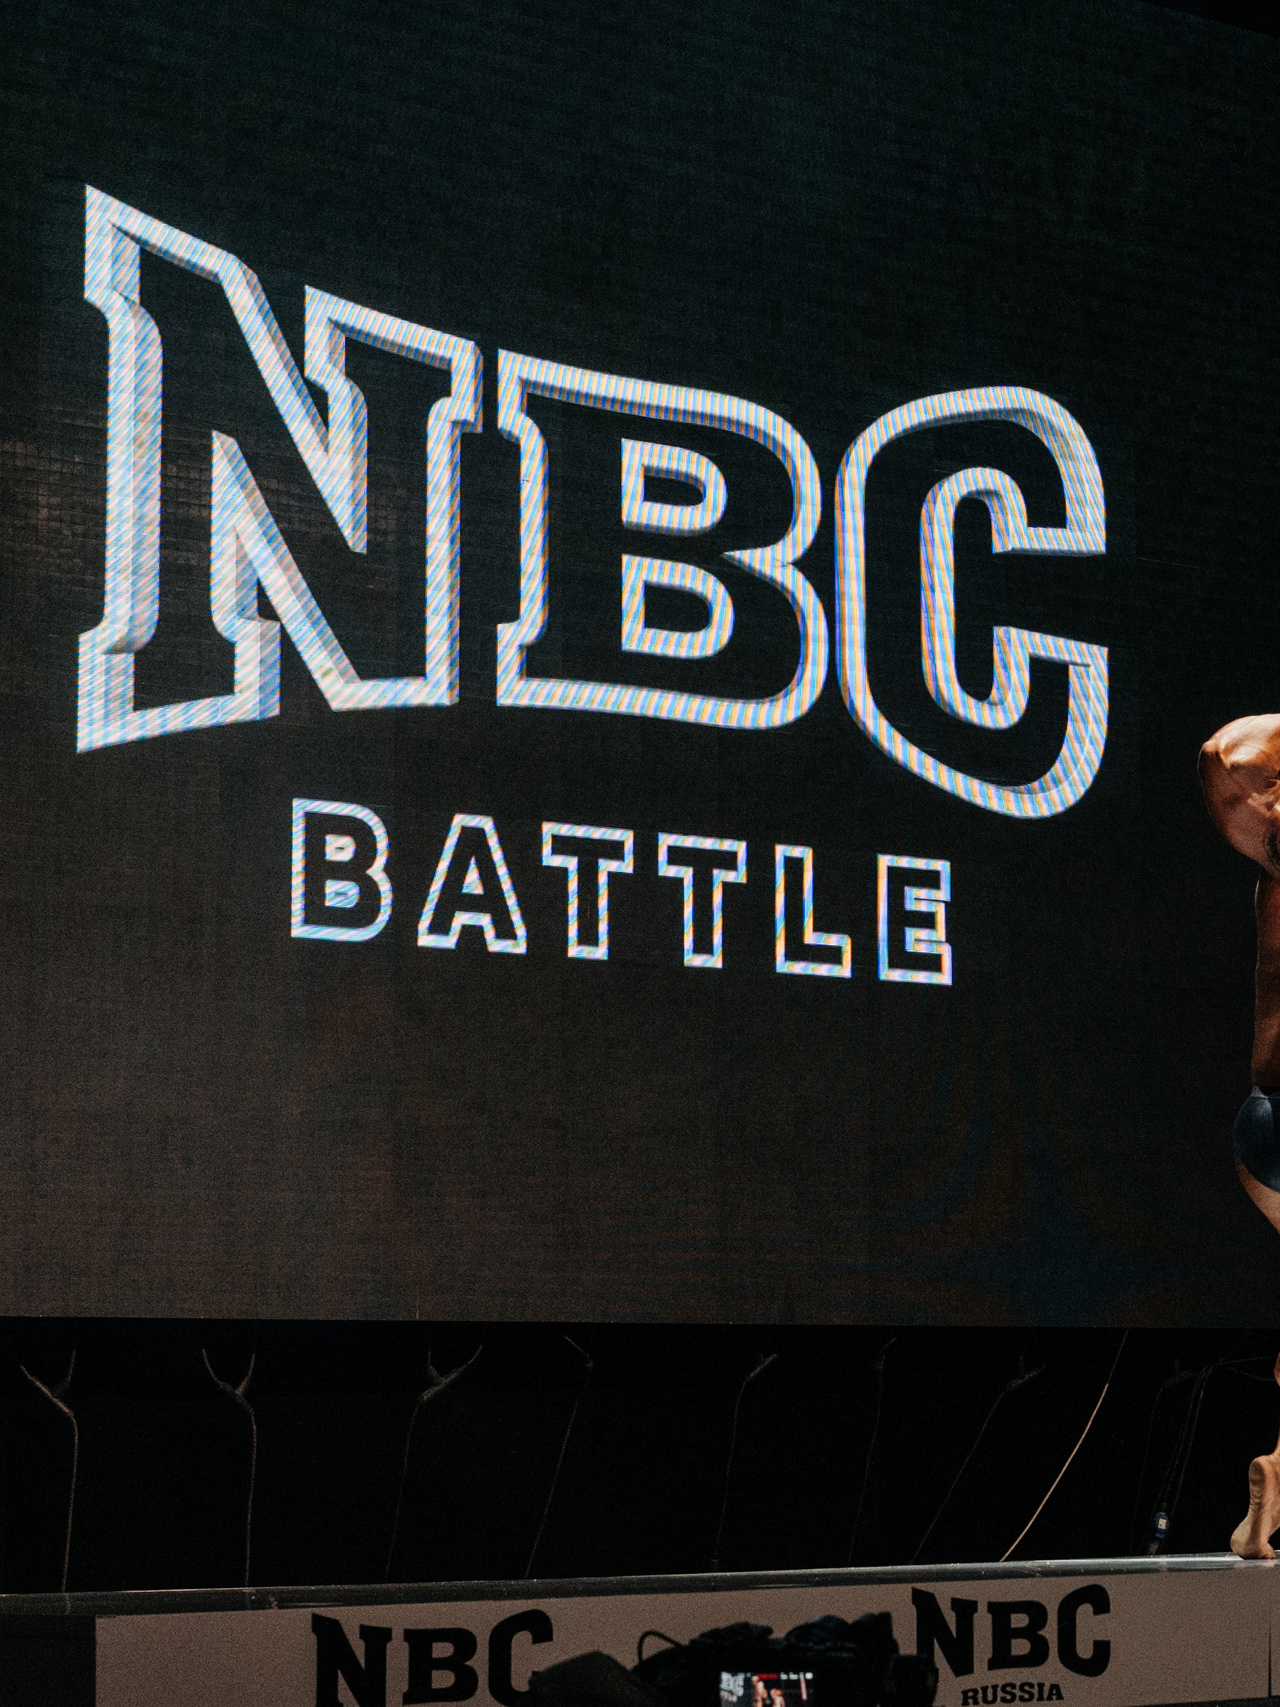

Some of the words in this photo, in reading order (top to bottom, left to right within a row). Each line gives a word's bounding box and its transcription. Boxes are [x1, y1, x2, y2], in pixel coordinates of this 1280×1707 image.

[77, 184, 1109, 819] NBC
[290, 797, 954, 987] BATTLE
[311, 1609, 553, 1707] NBC
[911, 1584, 1111, 1678] NBC
[961, 1681, 1064, 1706] RUSSIA
